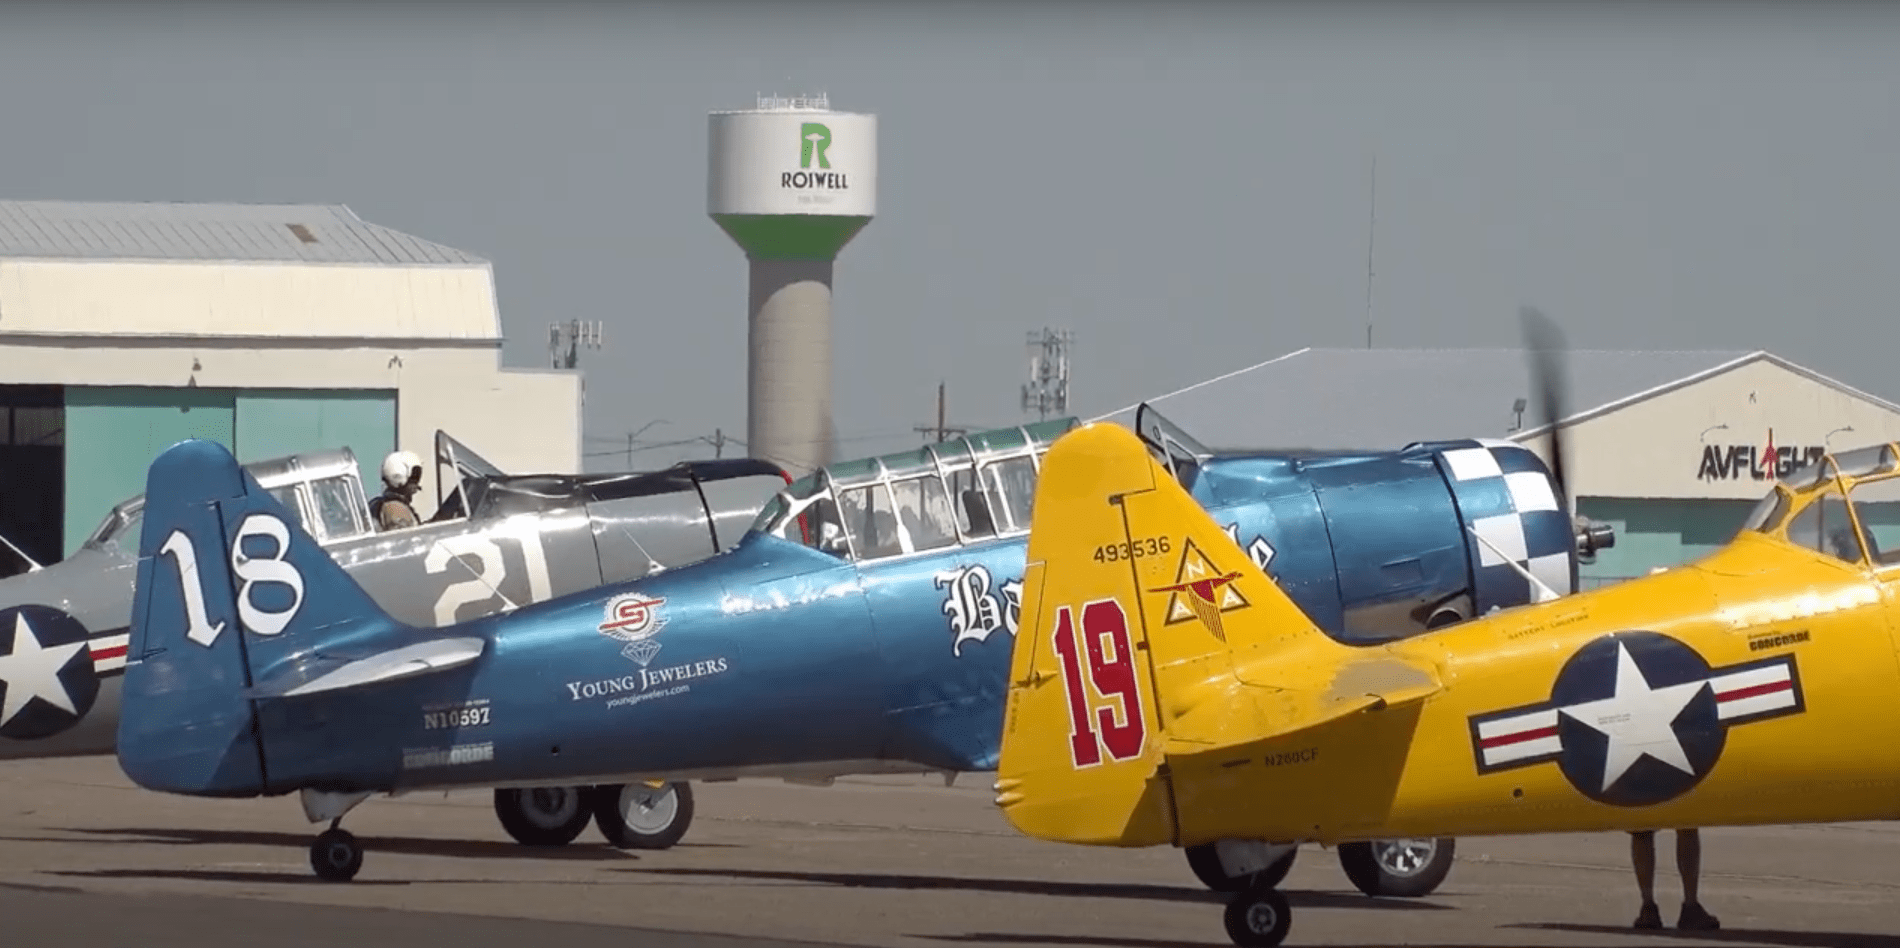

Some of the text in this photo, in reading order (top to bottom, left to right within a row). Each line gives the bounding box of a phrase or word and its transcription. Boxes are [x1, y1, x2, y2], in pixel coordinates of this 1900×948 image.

[160, 513, 304, 648] 18
[424, 512, 552, 628] 21
[1093, 536, 1171, 563] 493536
[424, 706, 491, 731] N10597
[1053, 597, 1147, 770] 19
